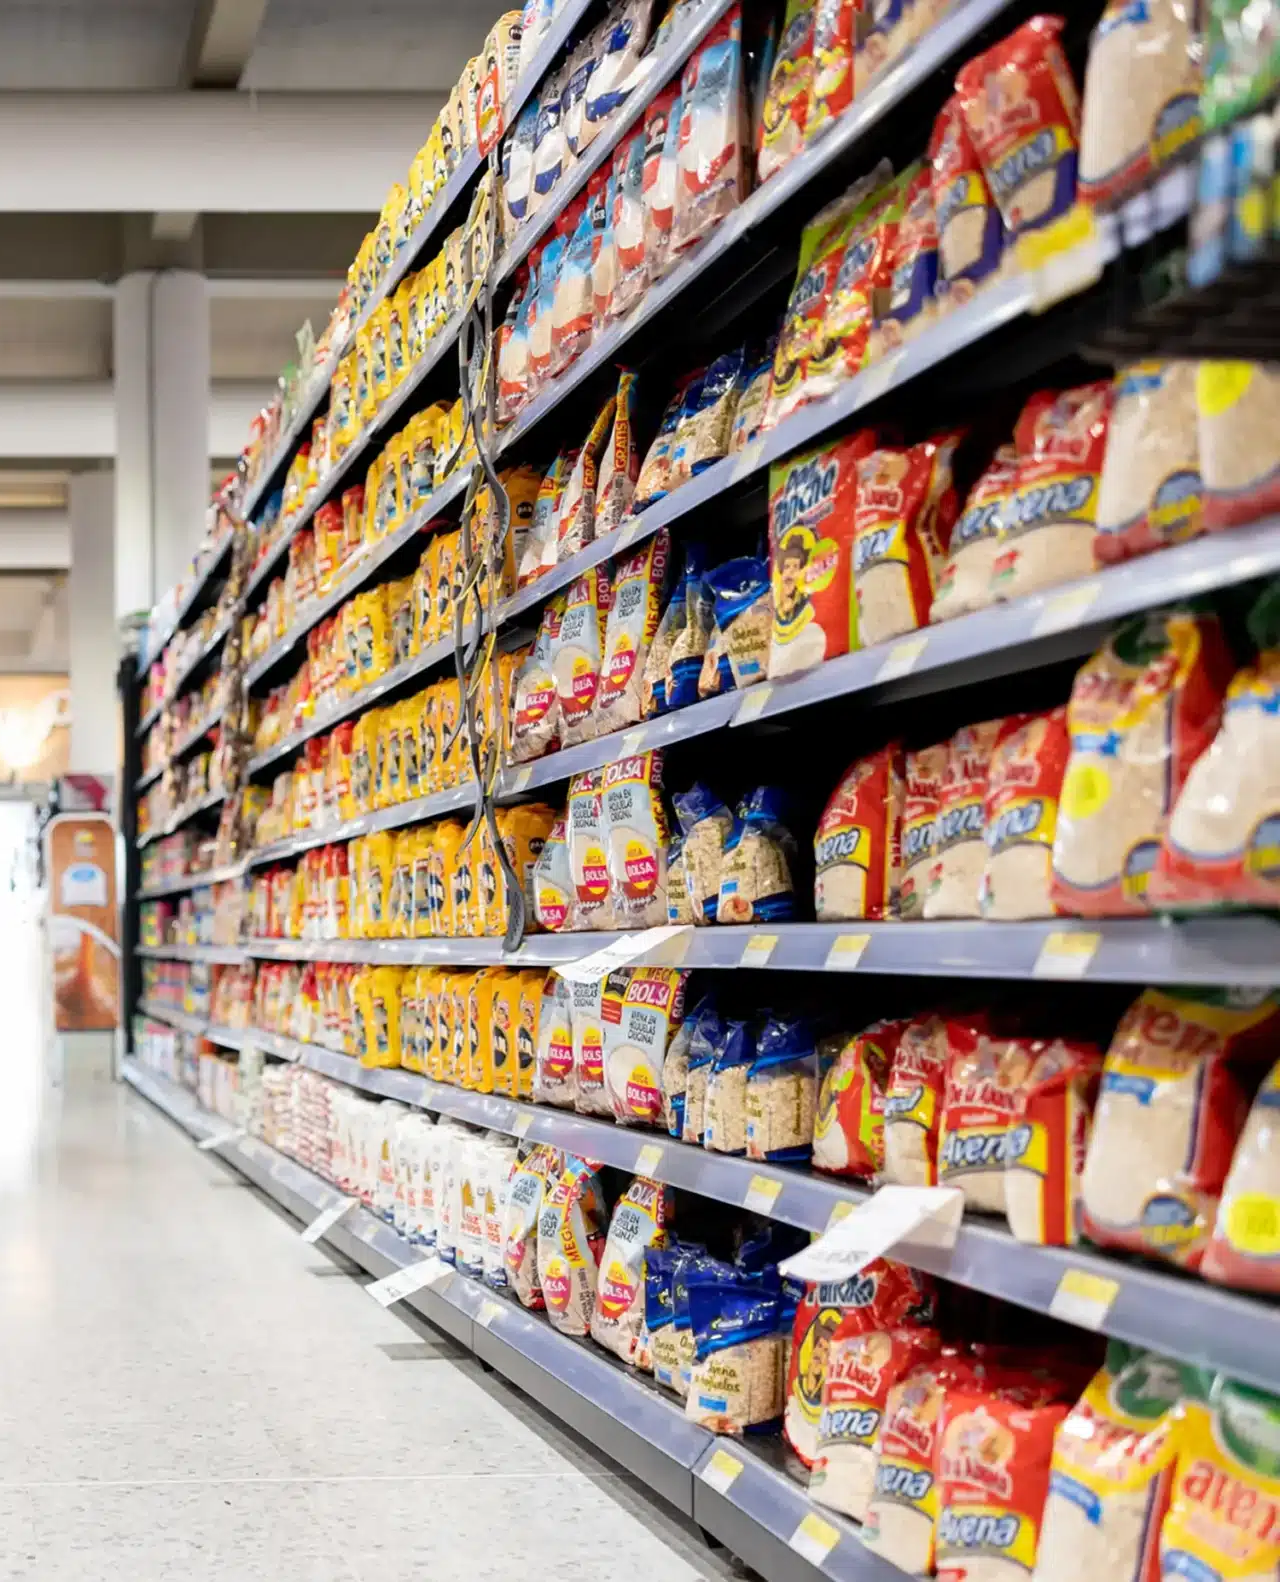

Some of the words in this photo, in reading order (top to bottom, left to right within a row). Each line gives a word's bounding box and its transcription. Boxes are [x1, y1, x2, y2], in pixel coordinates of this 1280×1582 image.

[585, 869, 608, 881] BOLSA
[626, 862, 654, 877] BOLSA
[583, 1049, 602, 1061] BOLS
[1182, 1459, 1280, 1542] aven
